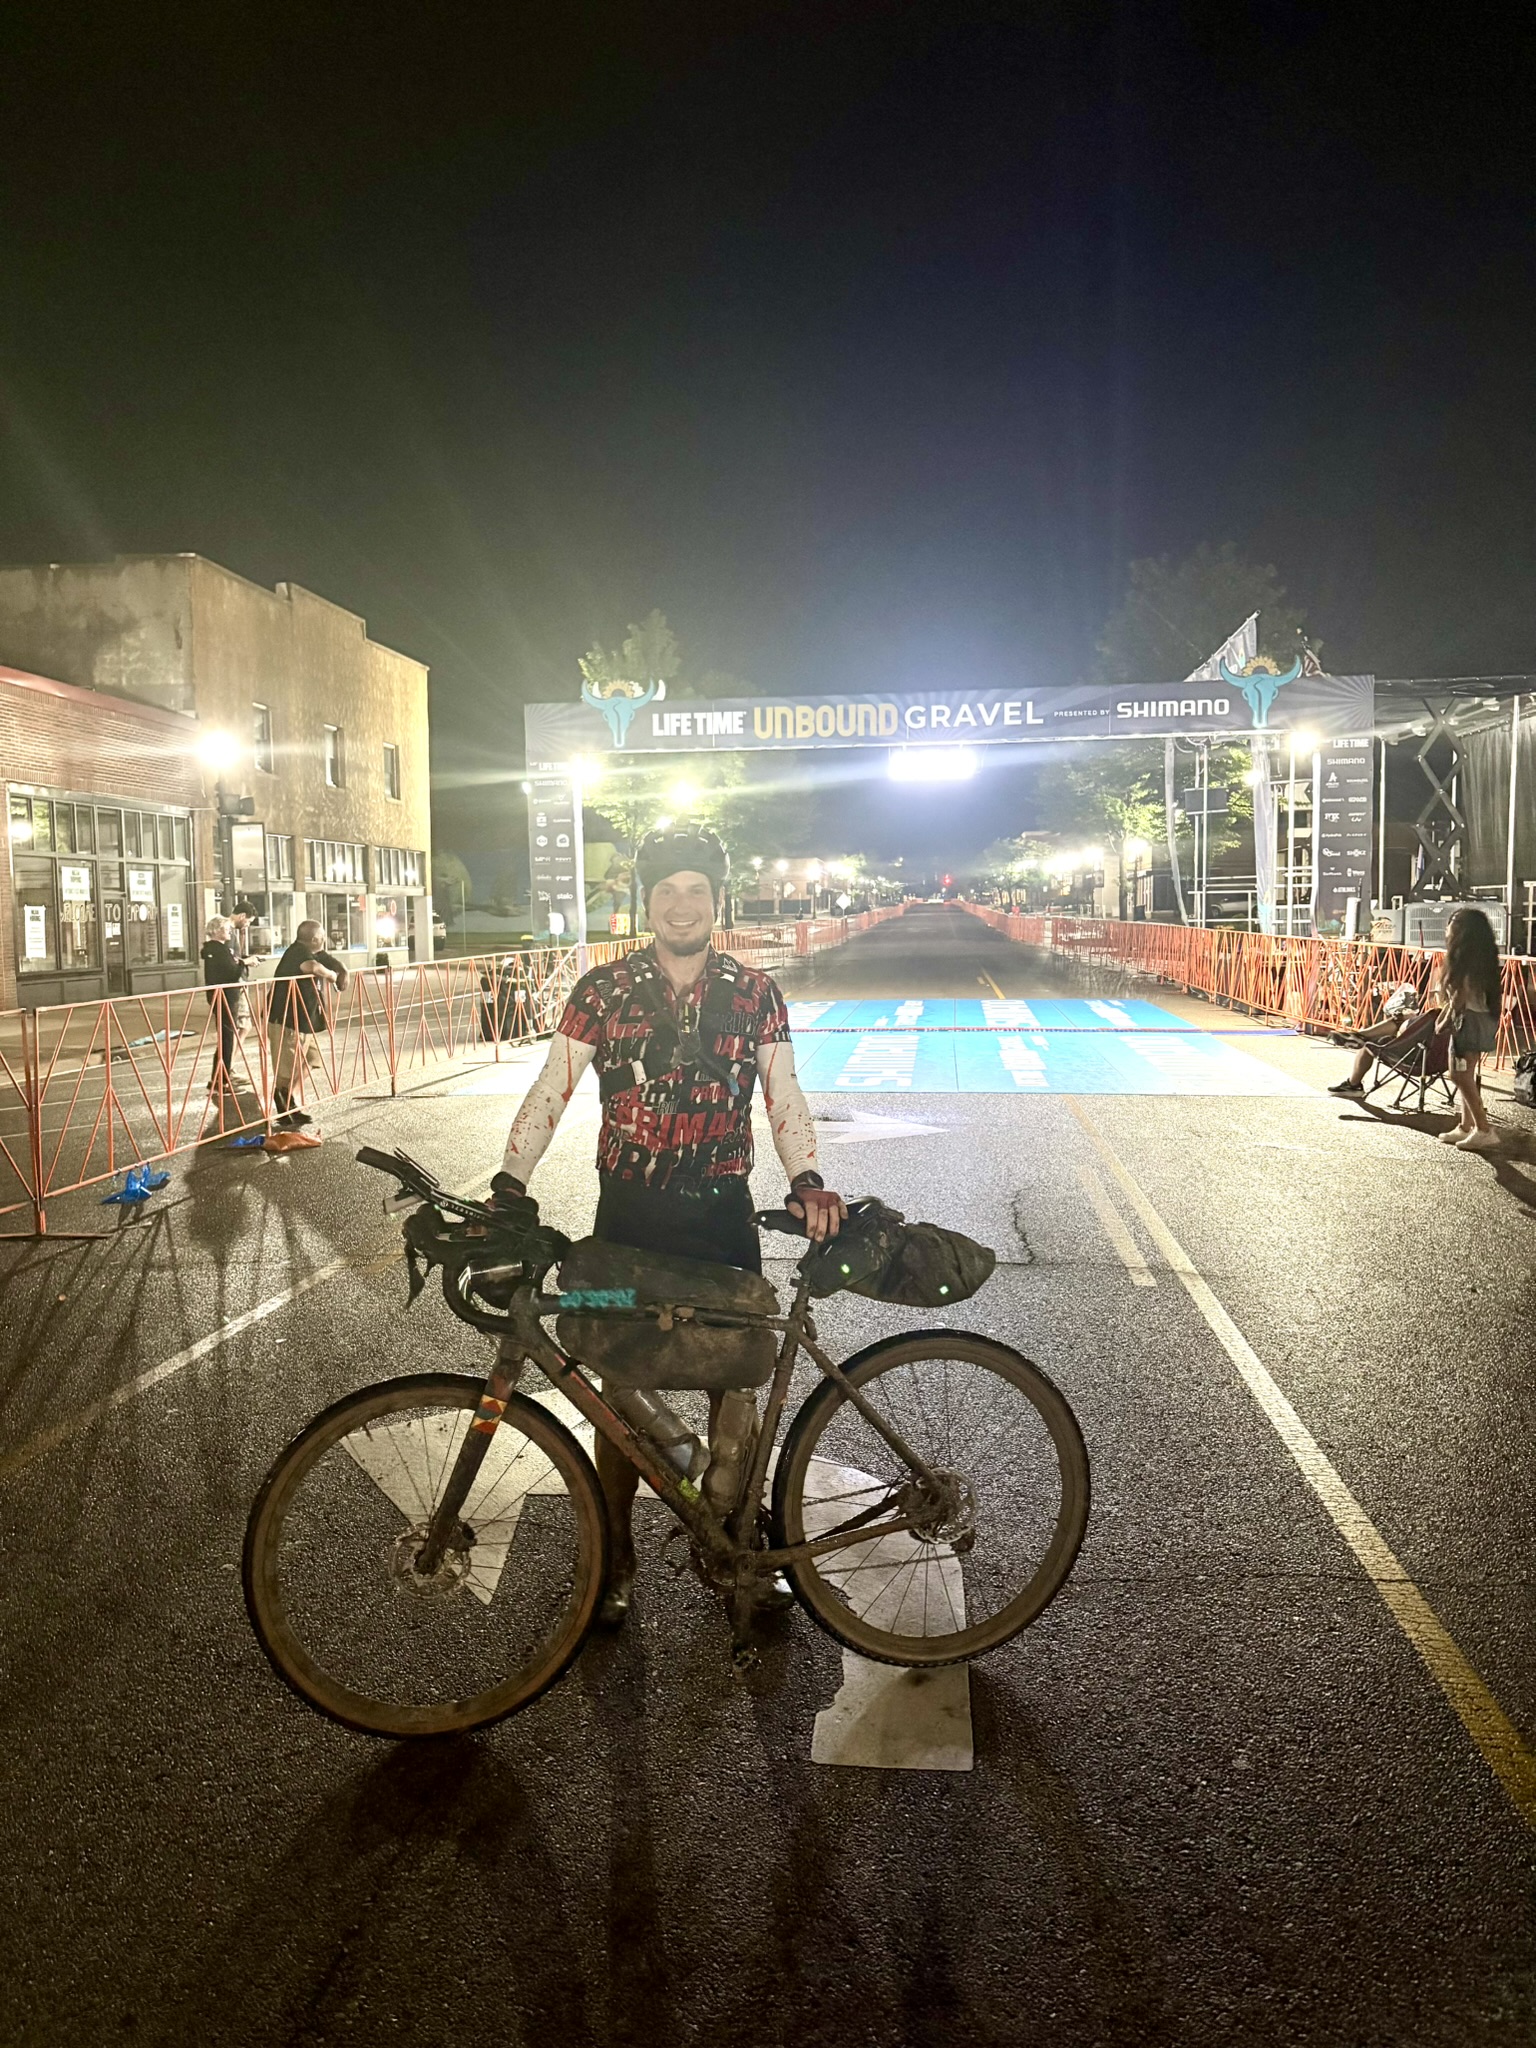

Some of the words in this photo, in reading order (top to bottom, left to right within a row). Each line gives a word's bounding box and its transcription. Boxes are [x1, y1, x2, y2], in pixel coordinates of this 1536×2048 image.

[754, 703, 899, 739] UNBOUND
[904, 701, 1045, 729] GRAVEL
[1053, 709, 1098, 718] PRESENTED
[1100, 709, 1111, 717] BY
[1116, 698, 1231, 719] SHIMANO
[1326, 757, 1366, 765] SHIMANO
[104, 903, 121, 922] TO
[834, 1034, 921, 1087] SHIMANO
